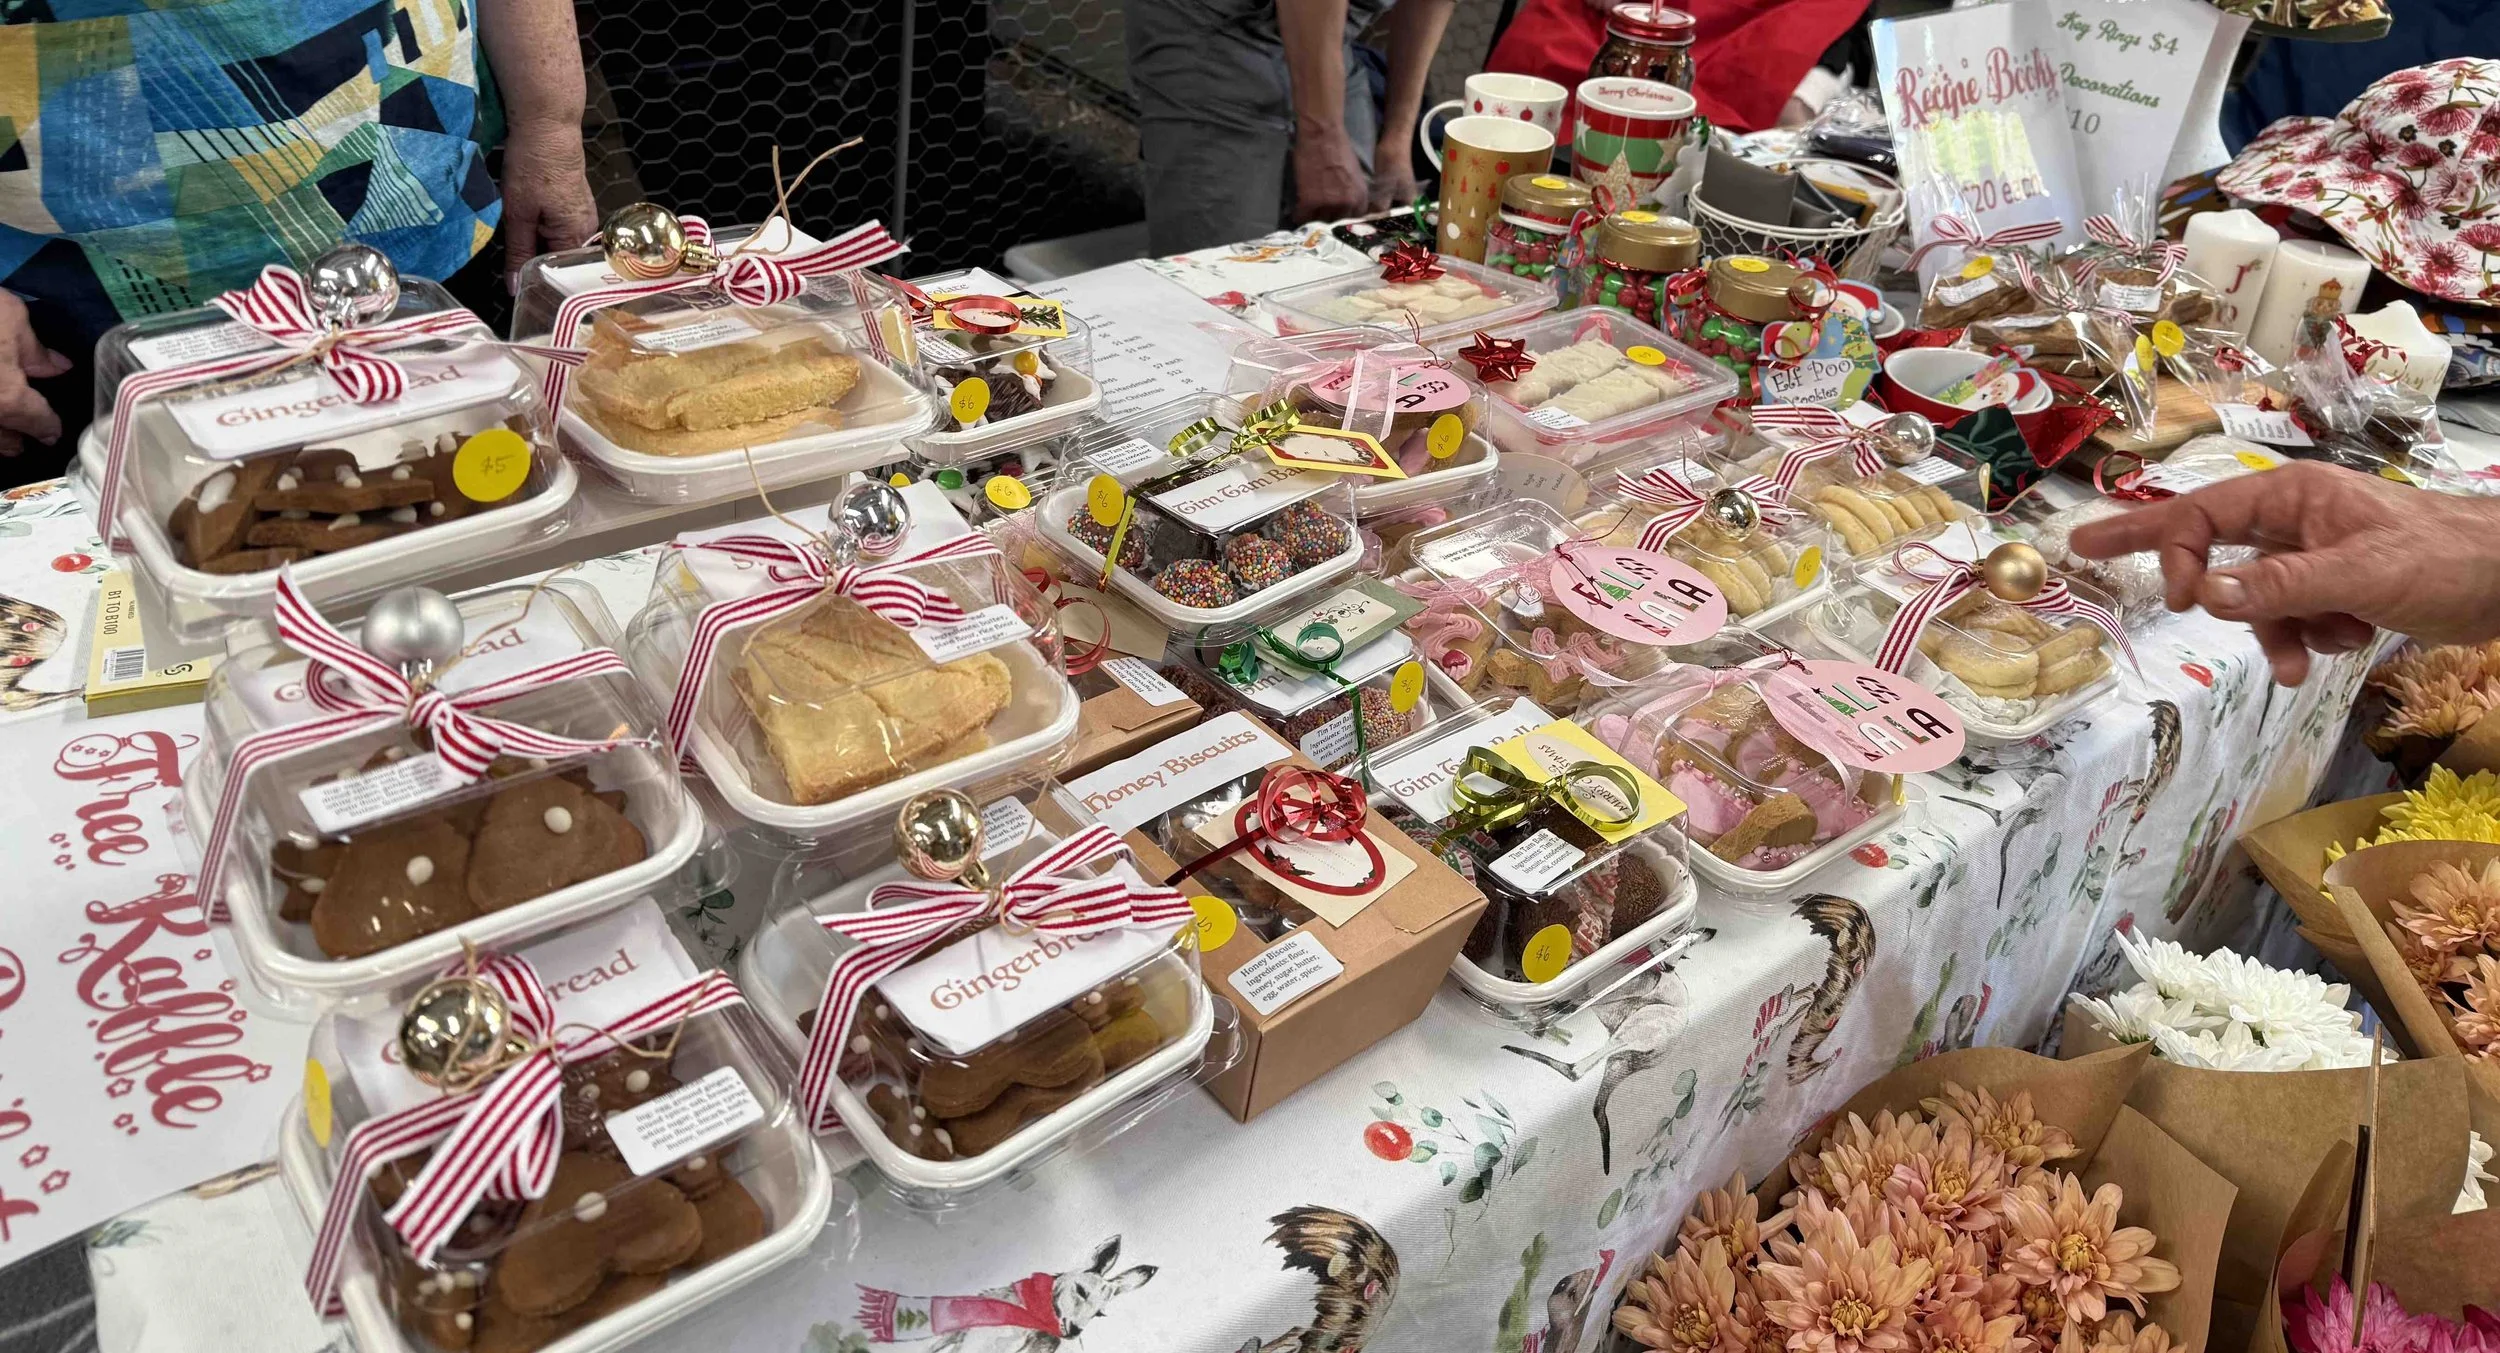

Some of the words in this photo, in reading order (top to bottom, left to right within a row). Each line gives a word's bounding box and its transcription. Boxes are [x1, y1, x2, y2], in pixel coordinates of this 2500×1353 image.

[2057, 10, 2092, 41] Key
[2099, 19, 2142, 52] Rings
[2149, 31, 2180, 56] $4
[1896, 66, 1982, 130] Recipe
[1986, 47, 2059, 104] Books
[2060, 62, 2161, 109] Decorations
[2065, 105, 2101, 135] 10
[1772, 366, 1803, 393] Elf
[1807, 359, 1851, 383] Poo
[959, 394, 974, 409] $6
[1172, 492, 1224, 517] Tim
[1218, 475, 1271, 500] Tam
[106, 601, 121, 614] TO
[108, 590, 122, 600] B1
[103, 614, 119, 635] B100
[1317, 728, 1329, 738] Tim
[1329, 721, 1342, 731] Tam
[1343, 712, 1354, 723] Ball
[1081, 770, 1168, 816] Honey
[1159, 729, 1258, 776] Biscuits
[1389, 771, 1446, 798] Tim
[54, 730, 200, 866] Free
[1592, 781, 1629, 813] MERRY
[1508, 849, 1522, 860] Tim
[1520, 842, 1536, 854] Tam
[1534, 832, 1549, 846] Balls
[1541, 840, 1554, 851] Tim
[1240, 957, 1267, 978] Honey
[1266, 940, 1298, 961] Biscuits
[1246, 958, 1289, 987] Ingredients:
[1288, 948, 1309, 962] flour,
[1249, 980, 1276, 998] honey,
[1274, 966, 1298, 982] sugar,
[1296, 953, 1320, 968] butter,
[1262, 989, 1279, 1002] egg,
[1277, 975, 1302, 992] water,
[1300, 963, 1324, 979] spices.
[58, 873, 262, 1130] Raffle
